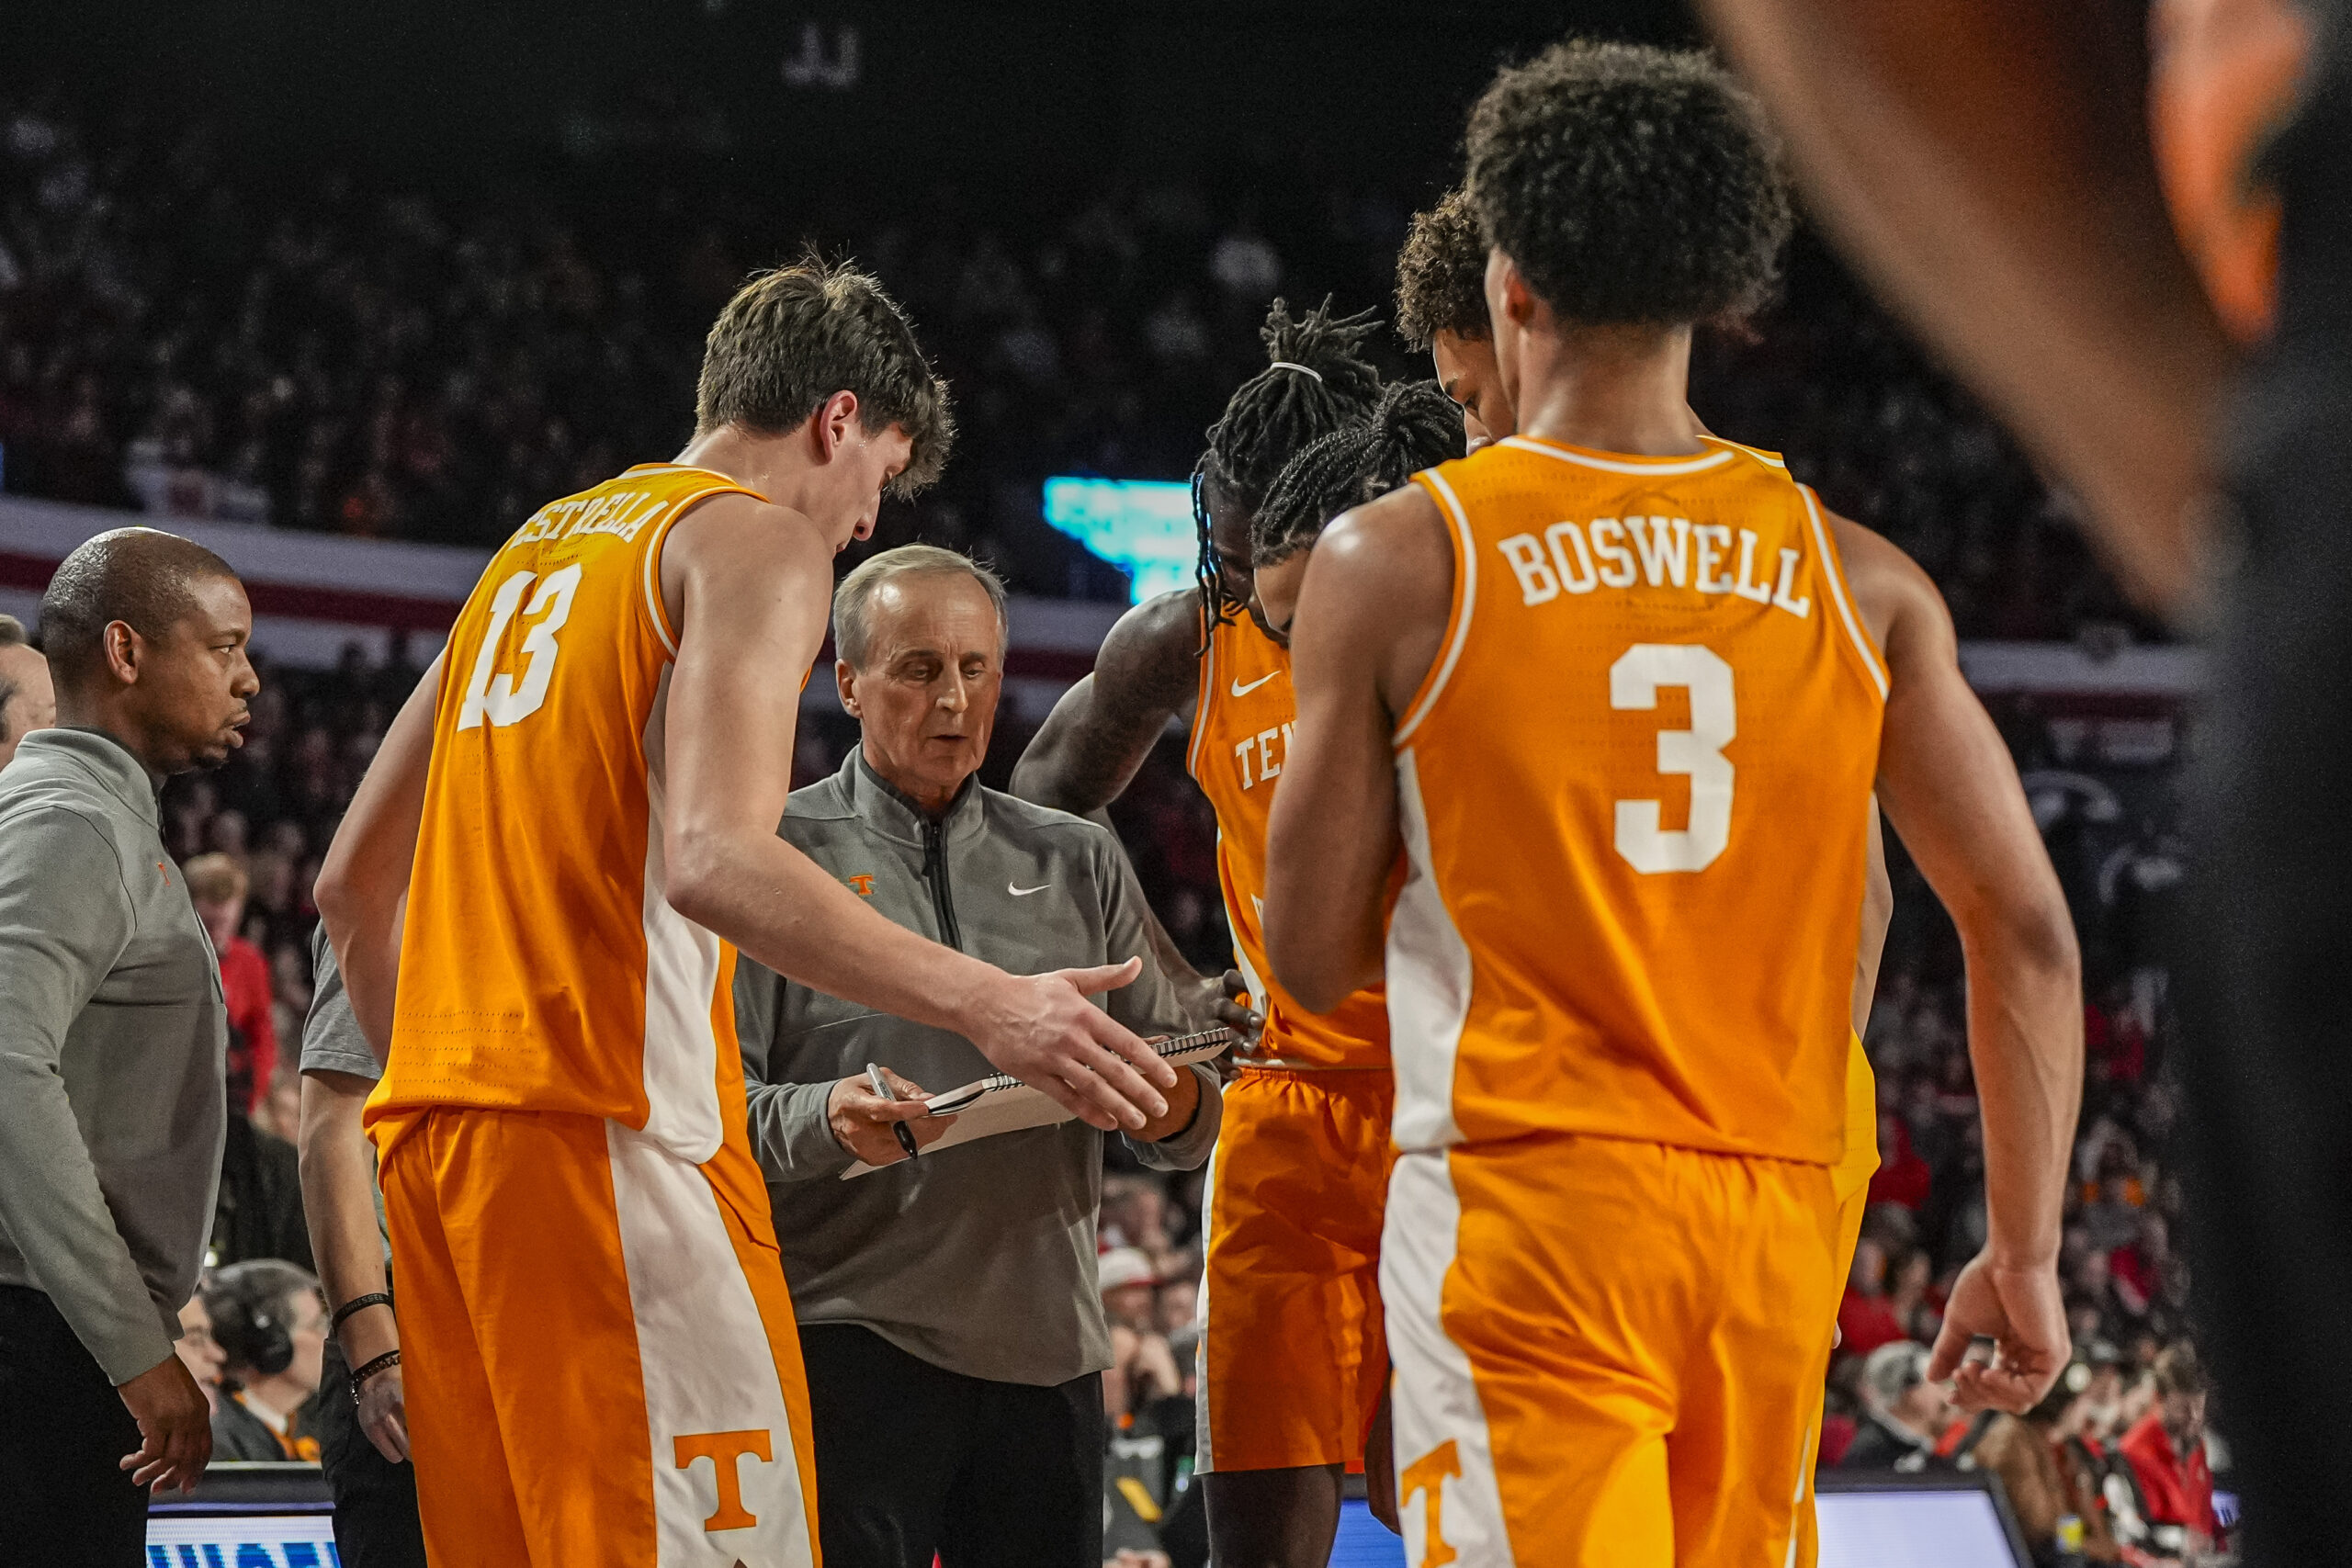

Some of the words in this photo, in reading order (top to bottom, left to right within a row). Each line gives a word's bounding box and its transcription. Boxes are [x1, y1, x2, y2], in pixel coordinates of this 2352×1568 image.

[1497, 515, 1811, 618] BOSWELL
[457, 562, 582, 732] 13
[1609, 643, 1737, 874] 3
[849, 874, 874, 896] T
[673, 1429, 773, 1532] T
[1400, 1438, 1463, 1568] T
